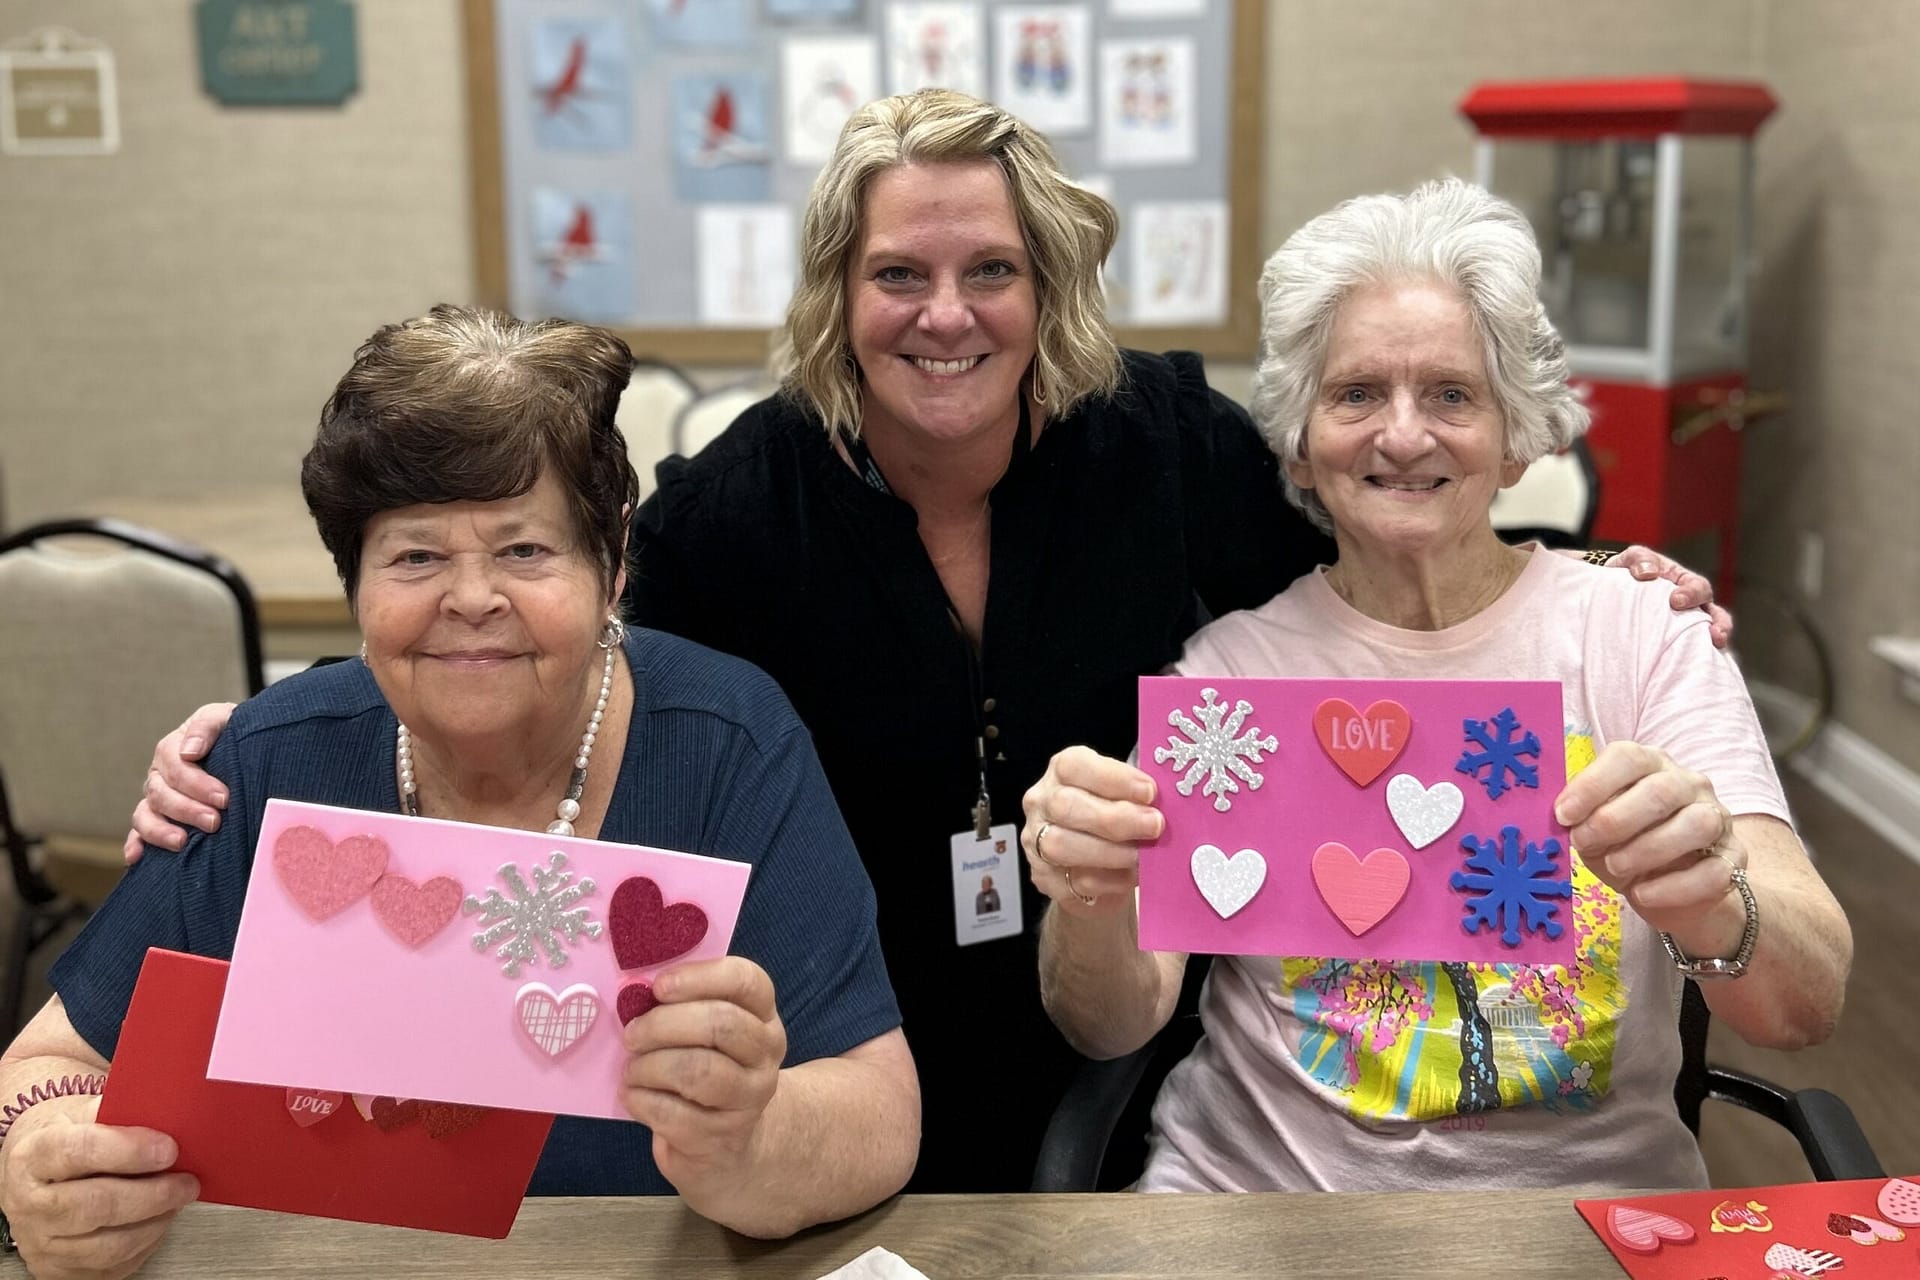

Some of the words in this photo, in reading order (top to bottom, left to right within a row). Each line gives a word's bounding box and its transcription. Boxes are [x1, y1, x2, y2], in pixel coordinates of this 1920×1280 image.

[1331, 716, 1396, 752] LOVE
[289, 1095, 333, 1114] LOVE
[1439, 1116, 1486, 1132] 2019
